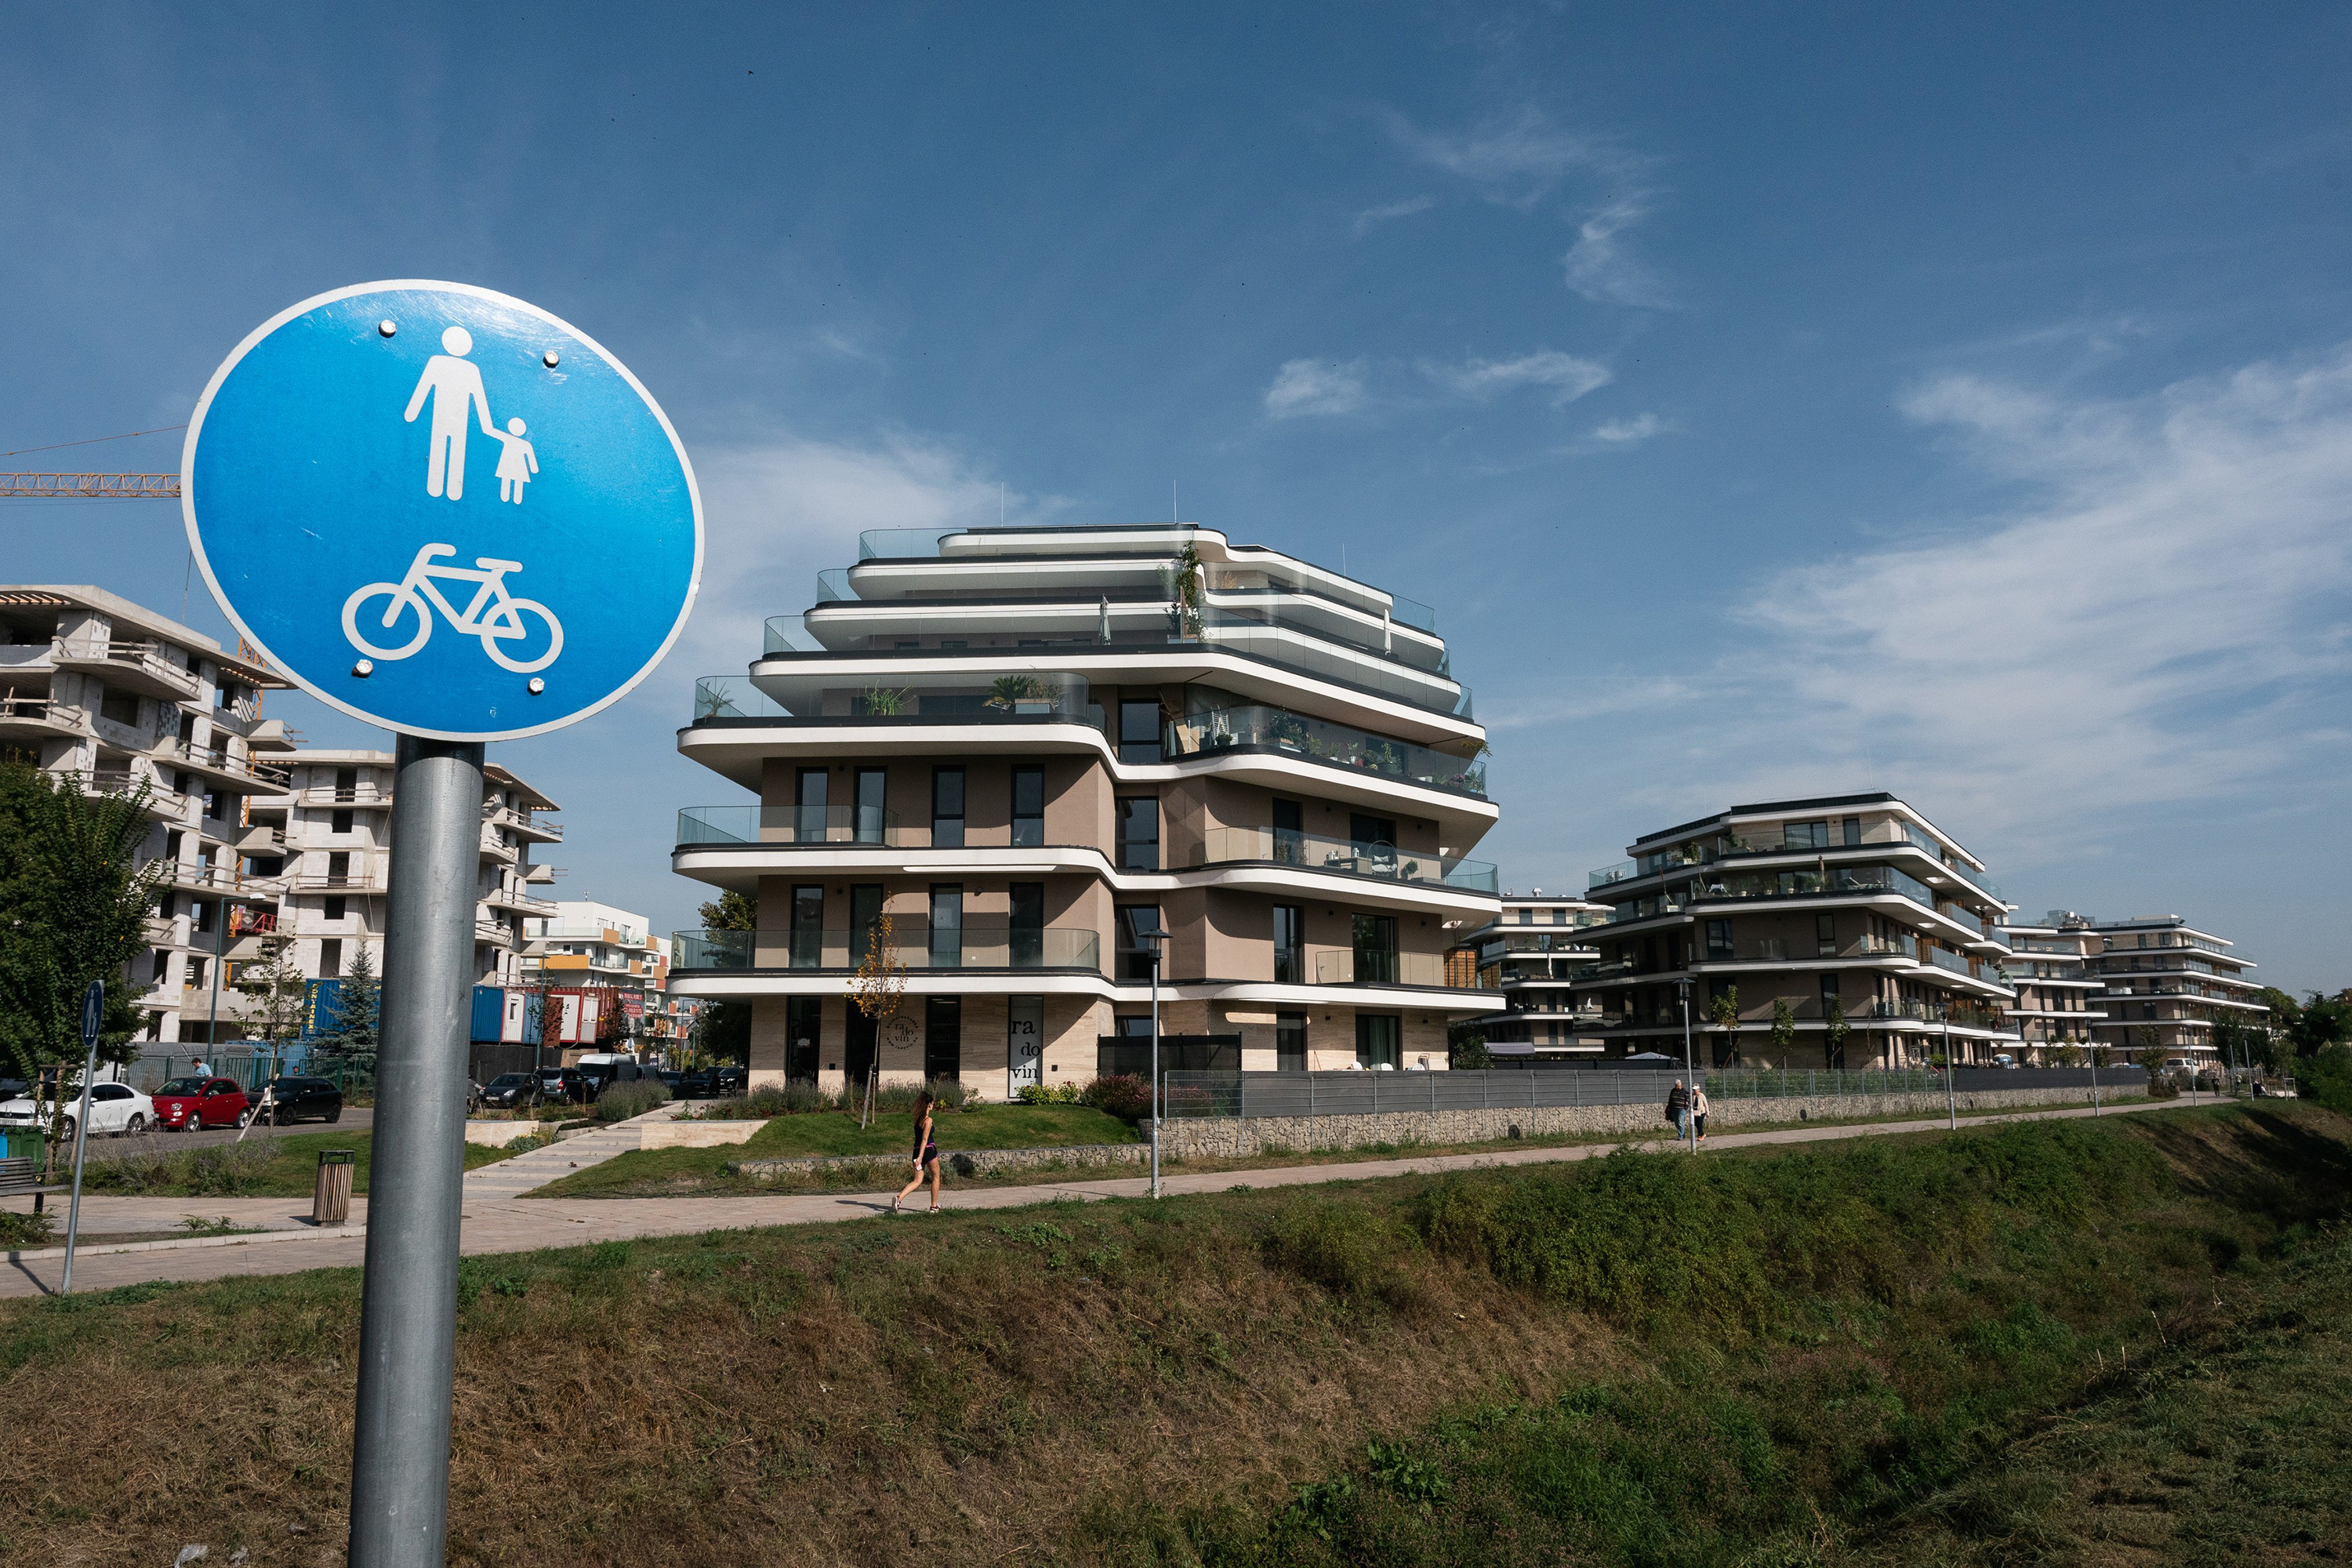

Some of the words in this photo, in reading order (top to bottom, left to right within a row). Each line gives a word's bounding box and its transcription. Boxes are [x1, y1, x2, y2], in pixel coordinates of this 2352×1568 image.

[308, 983, 318, 1029] CONTAINEX
[902, 1027, 913, 1036] do
[1011, 1020, 1036, 1035] ra
[1021, 1042, 1041, 1056] do
[1011, 1065, 1038, 1079] vin
